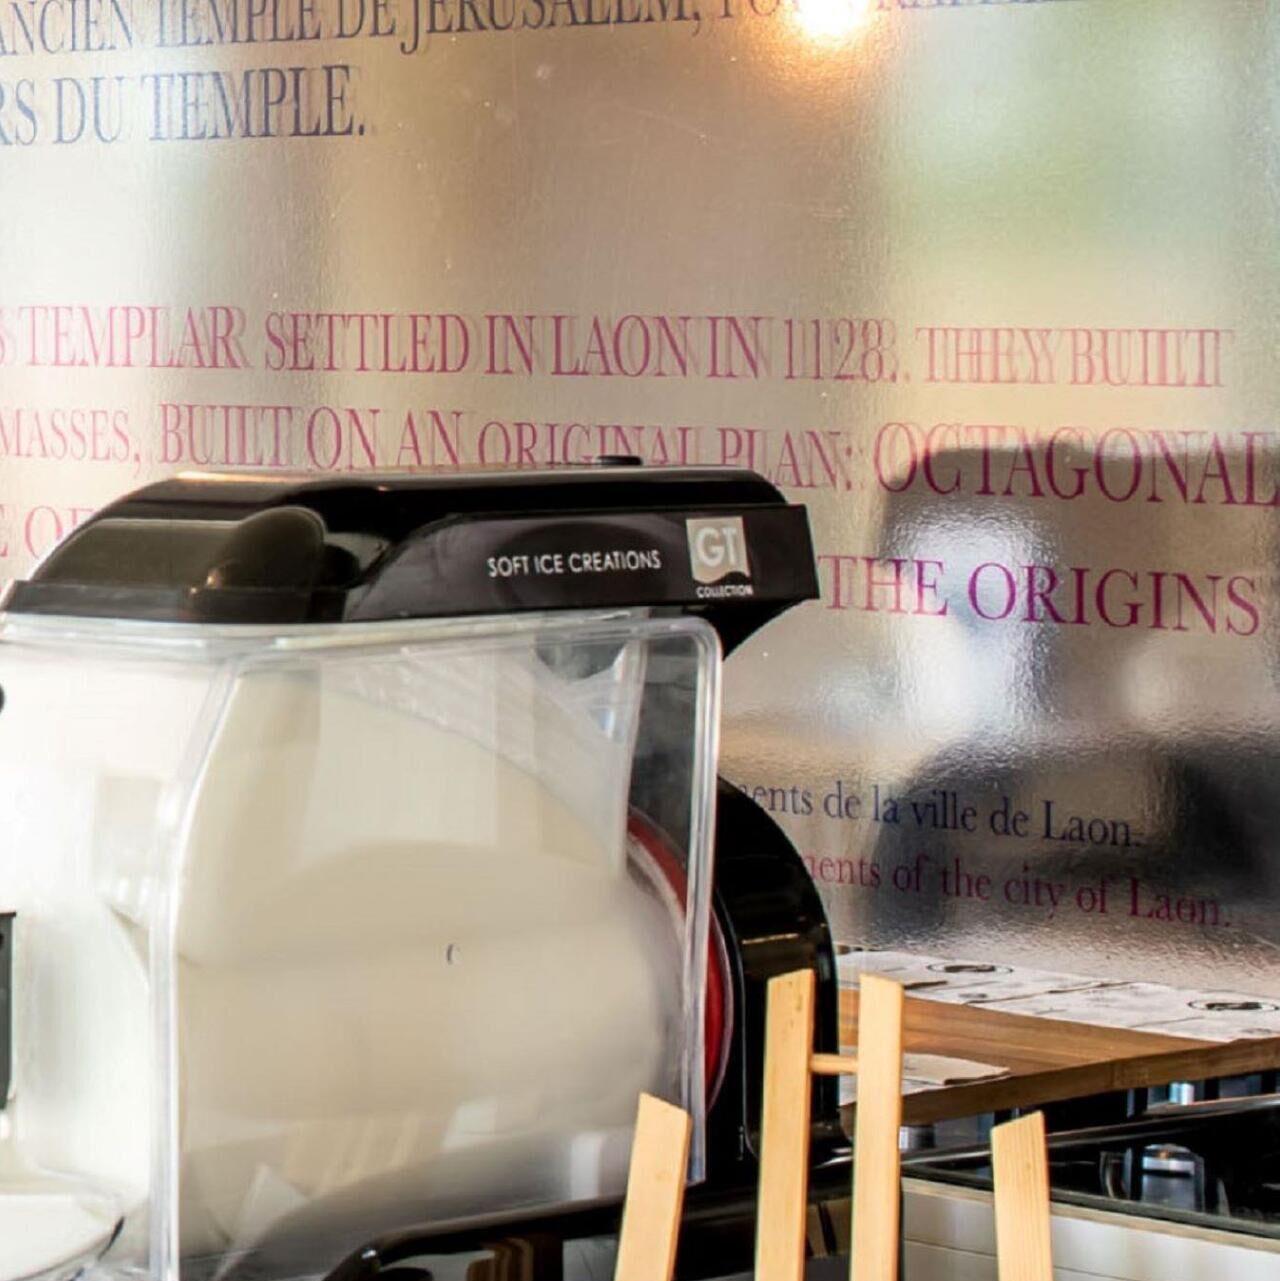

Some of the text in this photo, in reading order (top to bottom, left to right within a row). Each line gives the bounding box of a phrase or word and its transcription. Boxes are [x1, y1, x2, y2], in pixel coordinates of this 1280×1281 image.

[155, 0, 320, 48] TEMPLE
[337, 0, 396, 40] DE
[51, 76, 126, 145] DU
[142, 64, 366, 142] TEMPLE.
[19, 304, 244, 370] TEMPLAR
[264, 311, 470, 373] SETTLED
[484, 314, 538, 377] IN
[551, 313, 693, 378] LAON
[706, 315, 768, 379] IN
[917, 327, 1052, 384] THEY
[1060, 327, 1234, 387] BUILT
[158, 403, 295, 467] BUILT
[305, 405, 380, 470] ON
[397, 410, 464, 467] AN
[478, 420, 700, 466] ORIGINAL
[873, 421, 1280, 506] OCTAGONAL
[487, 550, 662, 577] SOFT ICE CREATIONS
[696, 526, 739, 567] GT
[817, 555, 1260, 637] THE ORIGINS
[824, 780, 863, 821] de
[873, 783, 901, 824] la
[912, 789, 978, 832] ville
[989, 796, 1029, 837] de
[1042, 800, 1143, 847] Laon.
[892, 854, 927, 892] of
[941, 858, 992, 902] the
[1003, 865, 1067, 921] city
[1076, 875, 1113, 914] of
[1130, 880, 1233, 928] Laon.
